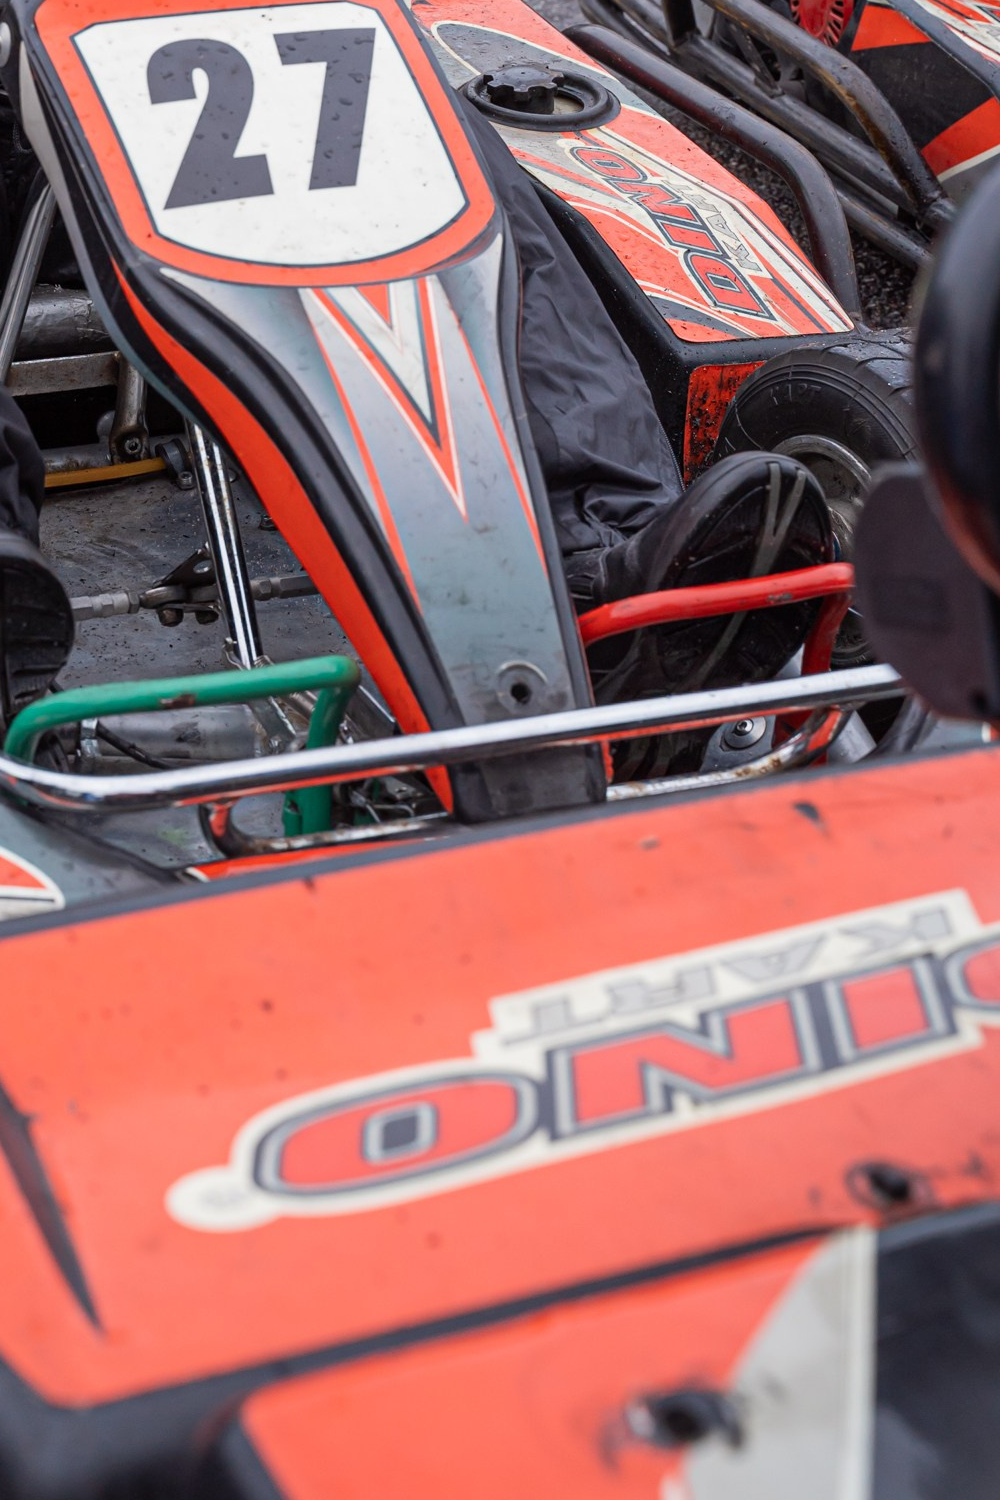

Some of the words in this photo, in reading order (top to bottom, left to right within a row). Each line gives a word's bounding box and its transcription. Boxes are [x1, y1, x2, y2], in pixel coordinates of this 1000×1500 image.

[146, 27, 377, 211] 27
[569, 145, 779, 322] DINO
[660, 179, 763, 272] KART
[253, 930, 1000, 1198] INO
[501, 905, 956, 1048] KART
